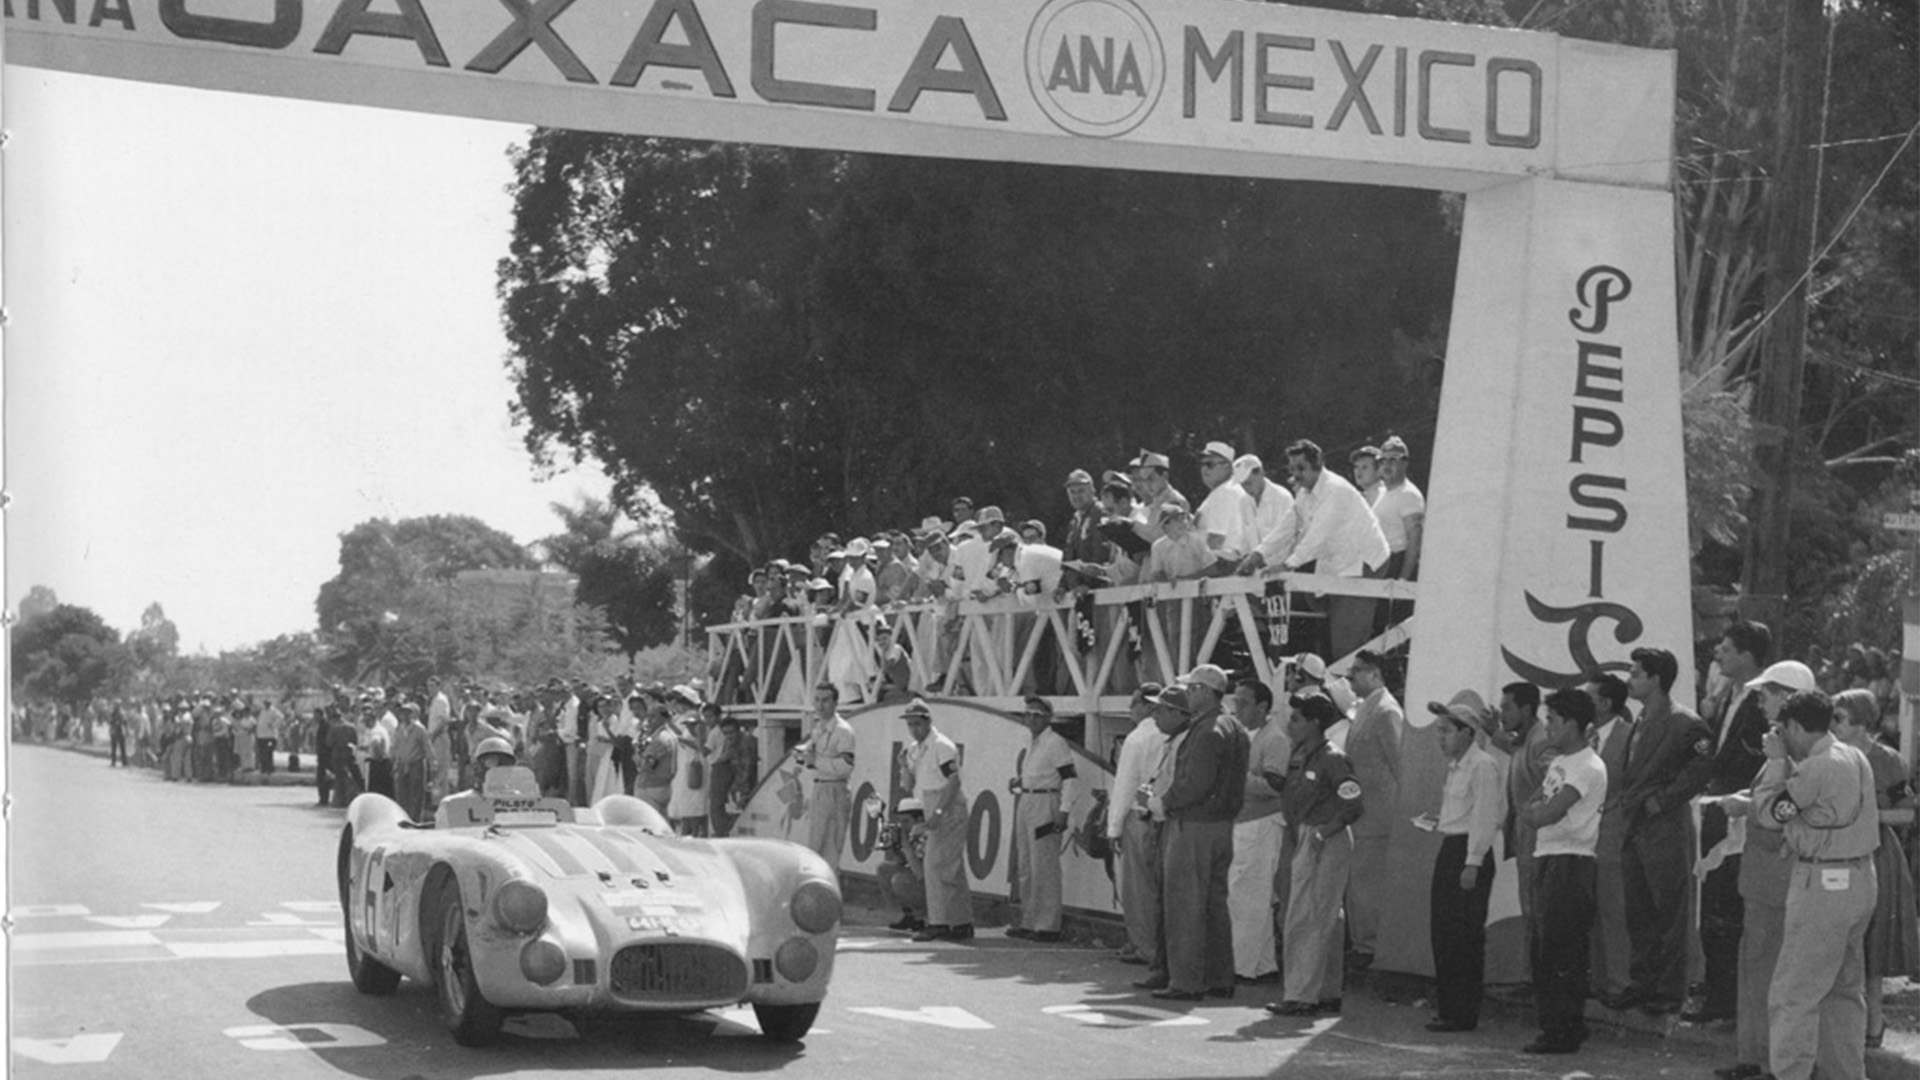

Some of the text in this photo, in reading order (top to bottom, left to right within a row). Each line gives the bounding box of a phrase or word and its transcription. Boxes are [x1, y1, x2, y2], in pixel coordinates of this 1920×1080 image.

[1045, 33, 1148, 99] ANA
[1182, 24, 1543, 150] MEXICO
[1566, 264, 1633, 600] PEPSI
[492, 799, 535, 809] PILOTO
